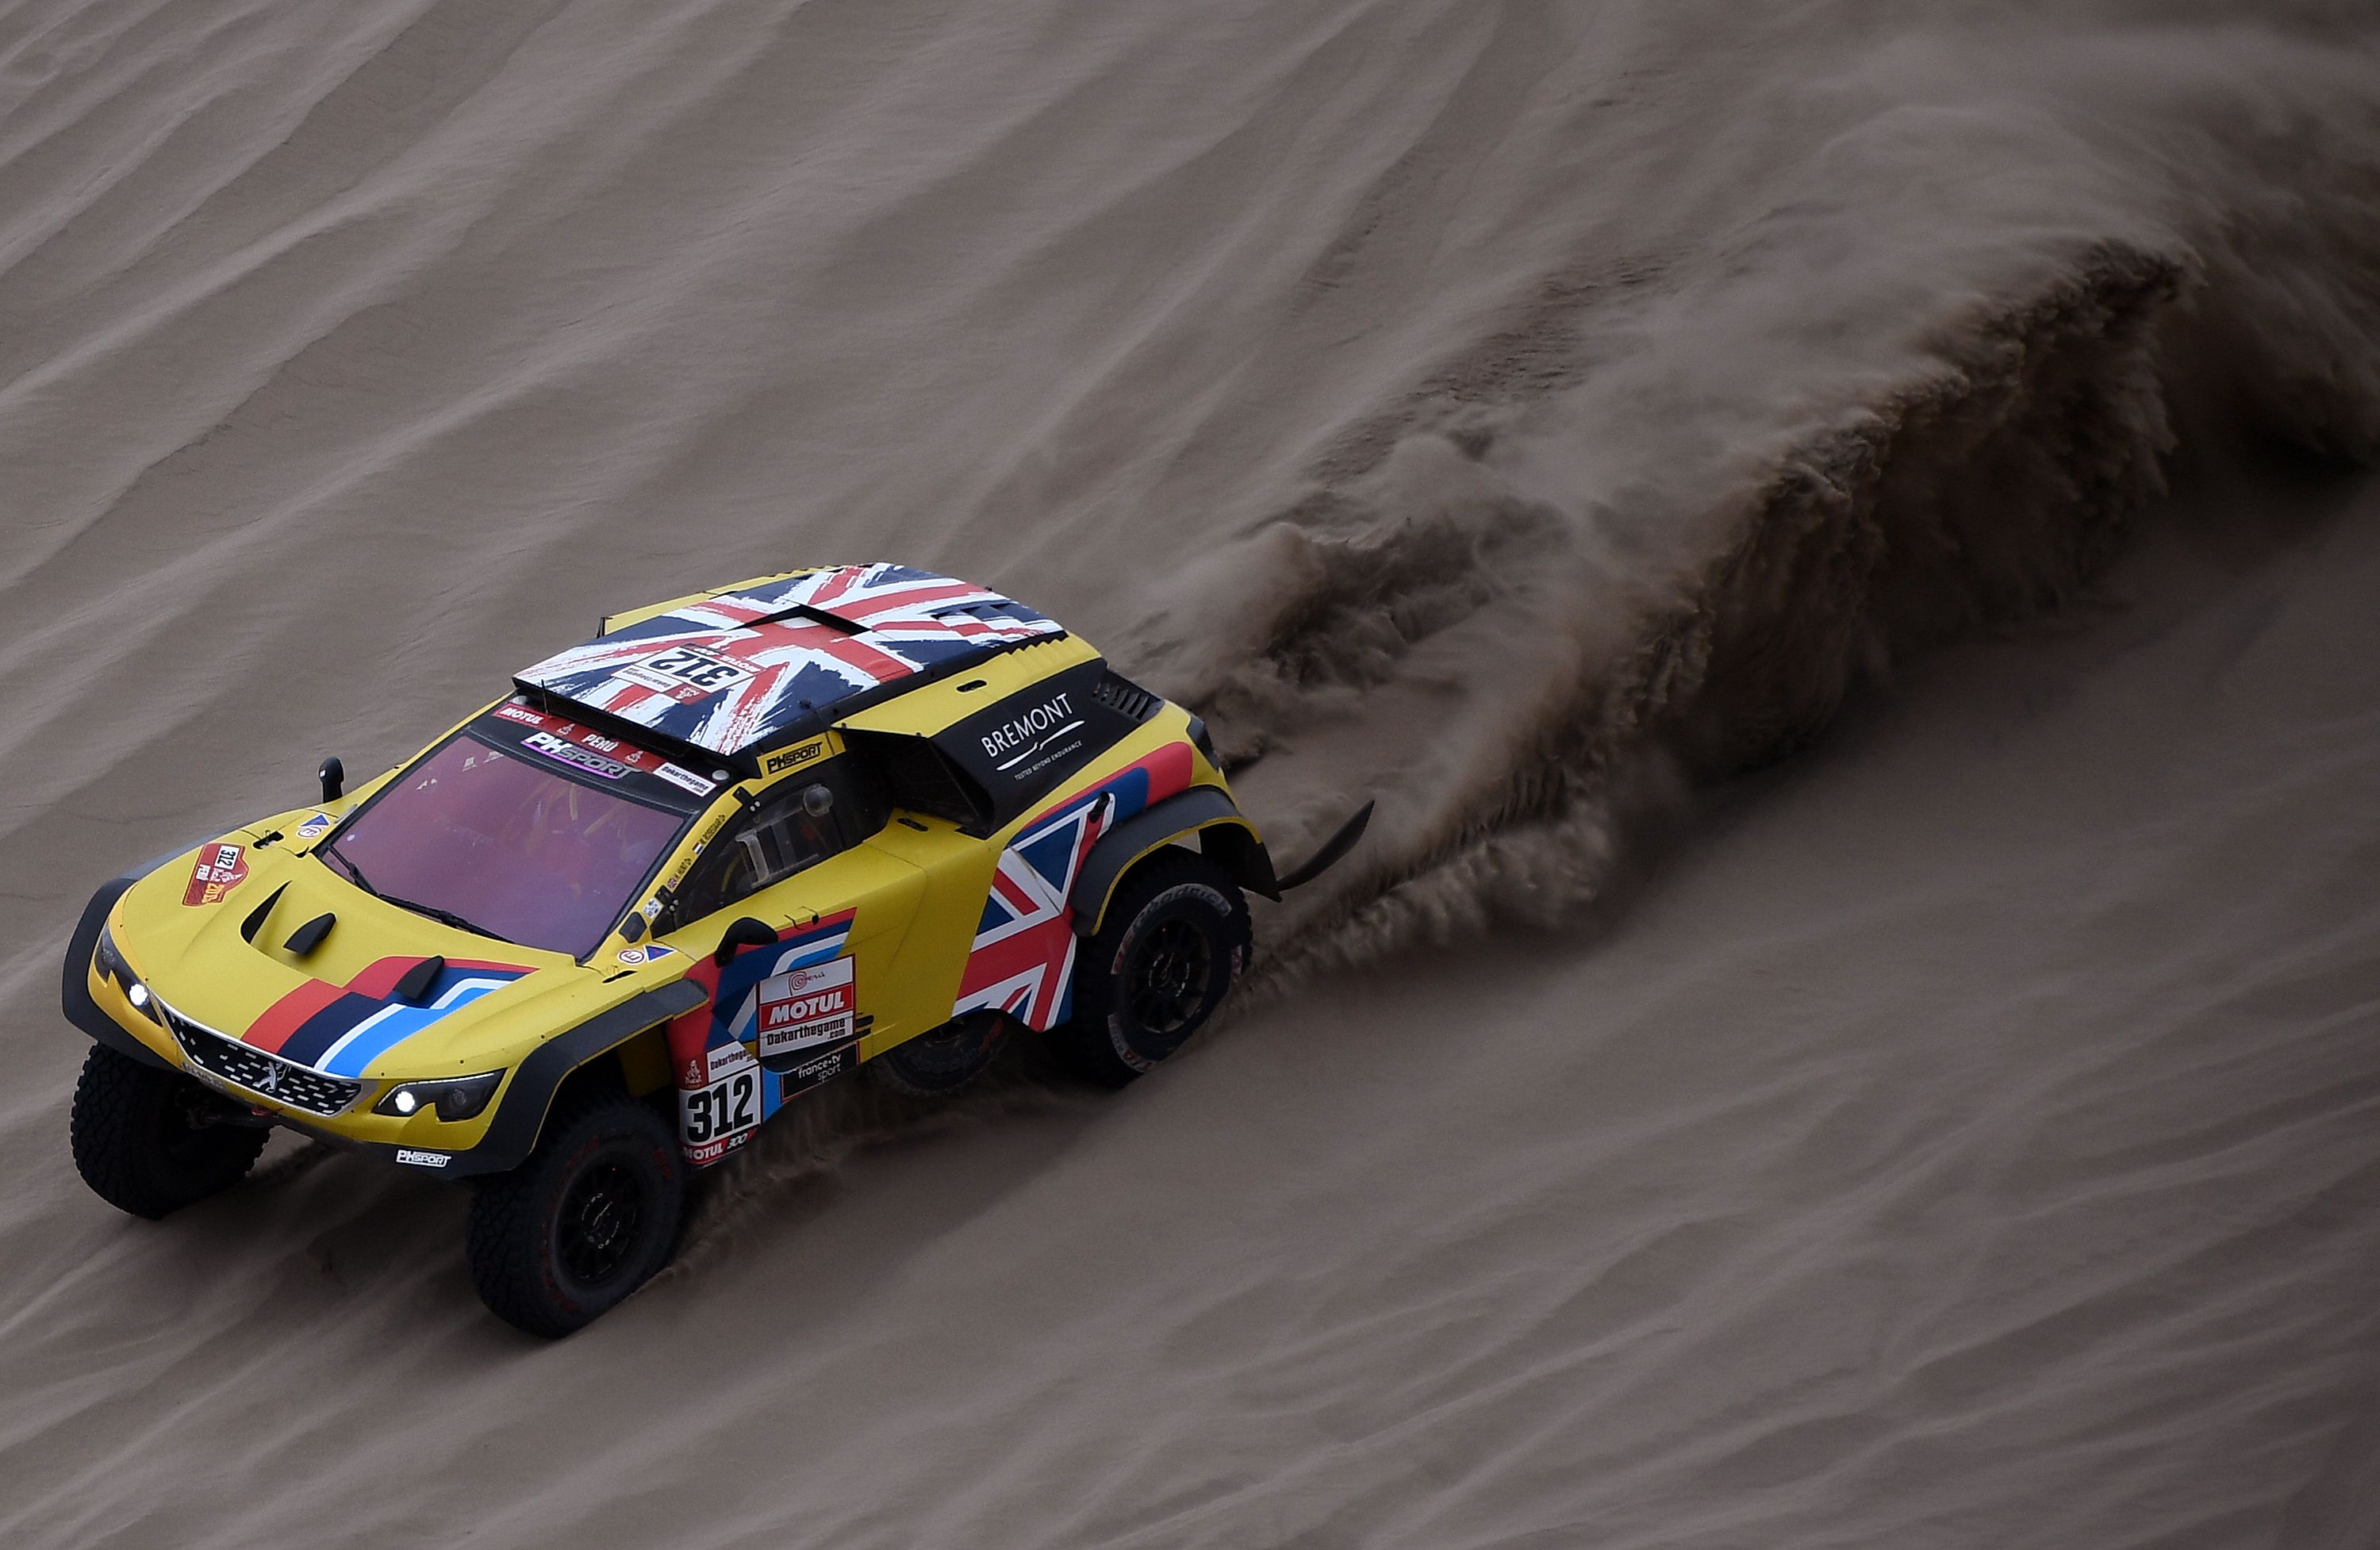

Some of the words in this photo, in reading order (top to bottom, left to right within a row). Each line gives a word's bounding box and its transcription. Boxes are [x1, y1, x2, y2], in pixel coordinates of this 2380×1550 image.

[648, 650, 739, 687] 312
[499, 707, 545, 726] MOTUL
[981, 692, 1073, 758] BREMONT
[217, 849, 236, 867] 312
[768, 991, 845, 1026] MOTUL
[767, 1018, 846, 1046] Dakarthegame
[827, 1028, 846, 1040] .com
[817, 1063, 841, 1084] sport
[687, 1074, 754, 1143] 312
[683, 1142, 724, 1161] MOTUL
